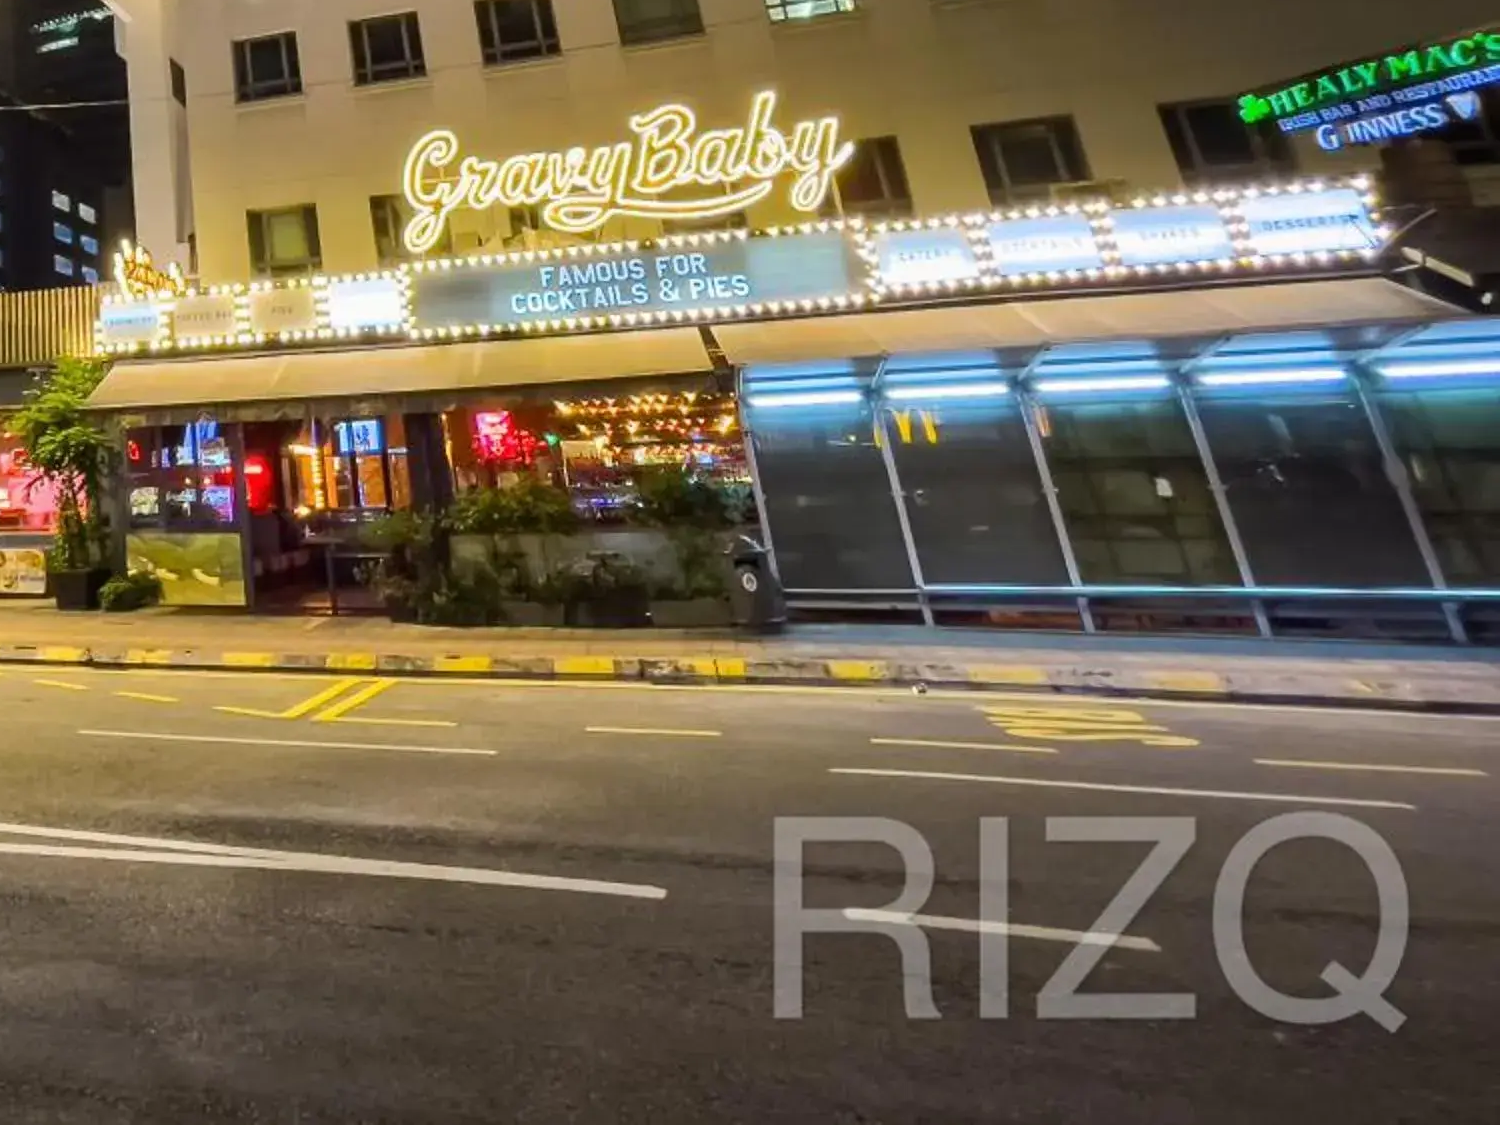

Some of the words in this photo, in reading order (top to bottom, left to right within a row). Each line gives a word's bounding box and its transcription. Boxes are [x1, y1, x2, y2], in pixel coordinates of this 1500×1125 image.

[1268, 62, 1380, 115] HEALY
[1320, 104, 1356, 122] BAR
[1356, 94, 1393, 112] AND
[402, 130, 631, 253] Gravy
[630, 89, 855, 212] Baby
[539, 258, 646, 288] FAMOUS
[655, 252, 707, 277] FOR
[511, 283, 649, 314] COCKTAILS
[659, 277, 681, 302] &
[689, 275, 750, 300] PIES
